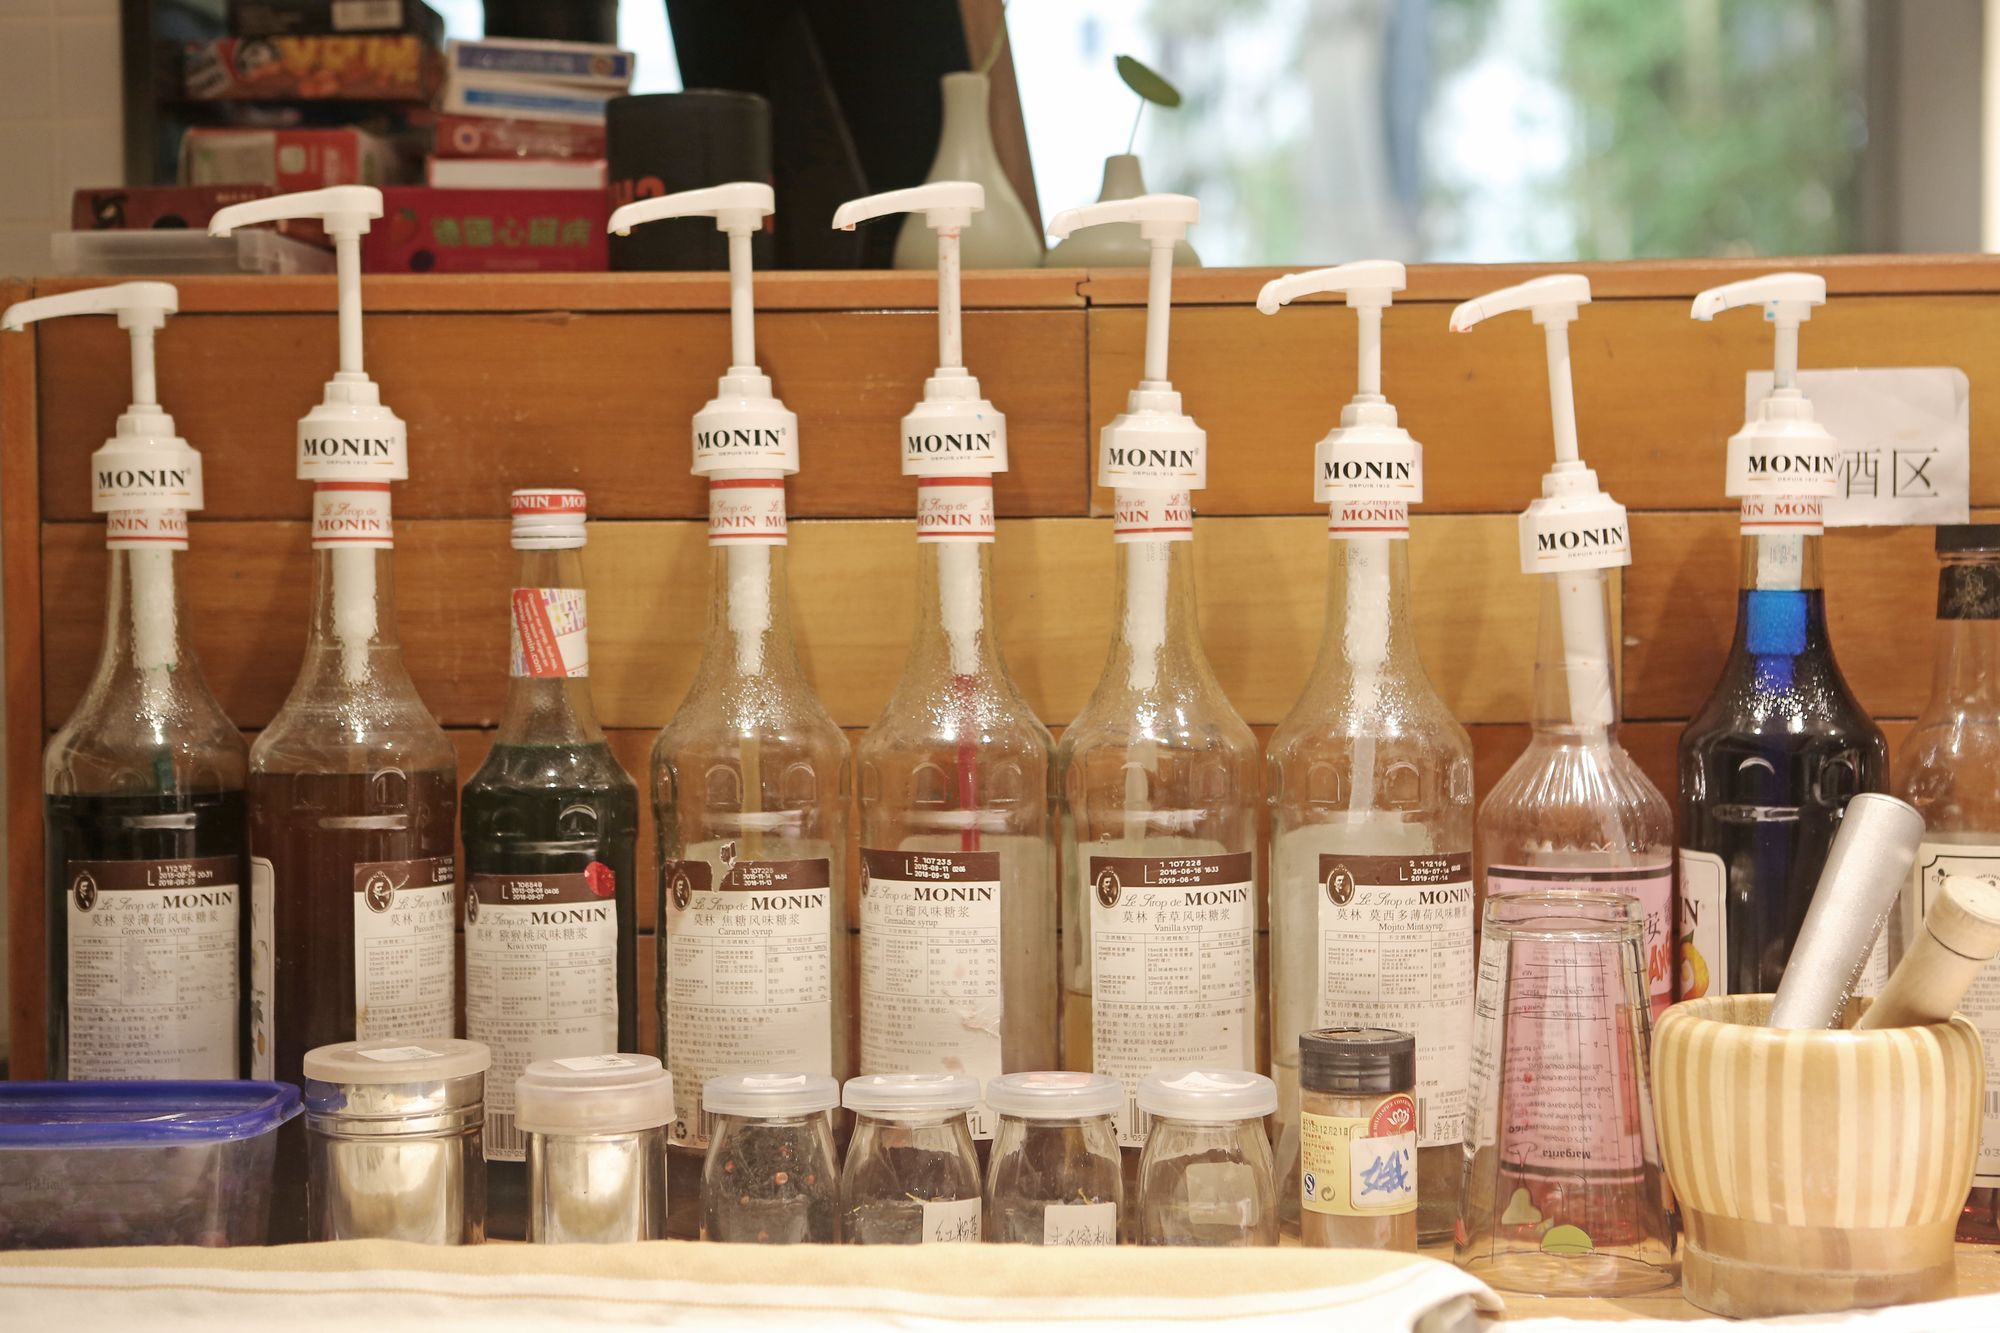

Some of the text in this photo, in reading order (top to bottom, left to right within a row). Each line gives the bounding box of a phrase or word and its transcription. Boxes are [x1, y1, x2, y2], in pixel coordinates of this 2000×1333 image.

[303, 438, 389, 456] MONIN
[698, 429, 780, 450] MONIN
[908, 433, 991, 453] MONIN
[1108, 447, 1193, 467] MONIN
[1747, 455, 1835, 473] MONIN
[1324, 461, 1410, 480] MONIN
[98, 470, 185, 490] MONIN
[1342, 510, 1404, 521] MONIN
[318, 520, 380, 531] MONIN
[1537, 526, 1623, 551] MONIN
[514, 598, 543, 674] www.monin.com
[163, 892, 233, 909] MONIN
[751, 894, 823, 910] MONIN
[914, 887, 992, 901] MONIN
[1185, 888, 1247, 906] MONIN
[1419, 888, 1471, 905] MONIN
[531, 908, 607, 925] MONIN
[918, 919, 938, 928] syrup
[1155, 909, 1230, 922] 香草风味糖浆
[121, 927, 146, 935] Green
[719, 928, 773, 938] Caramel syrup
[1154, 924, 1203, 933] Vanilla syrup
[1379, 922, 1443, 932] Mojito Mint syrup
[527, 942, 547, 951] syrup
[970, 1116, 987, 1134] 1L
[1542, 1147, 1591, 1160] Margarita
